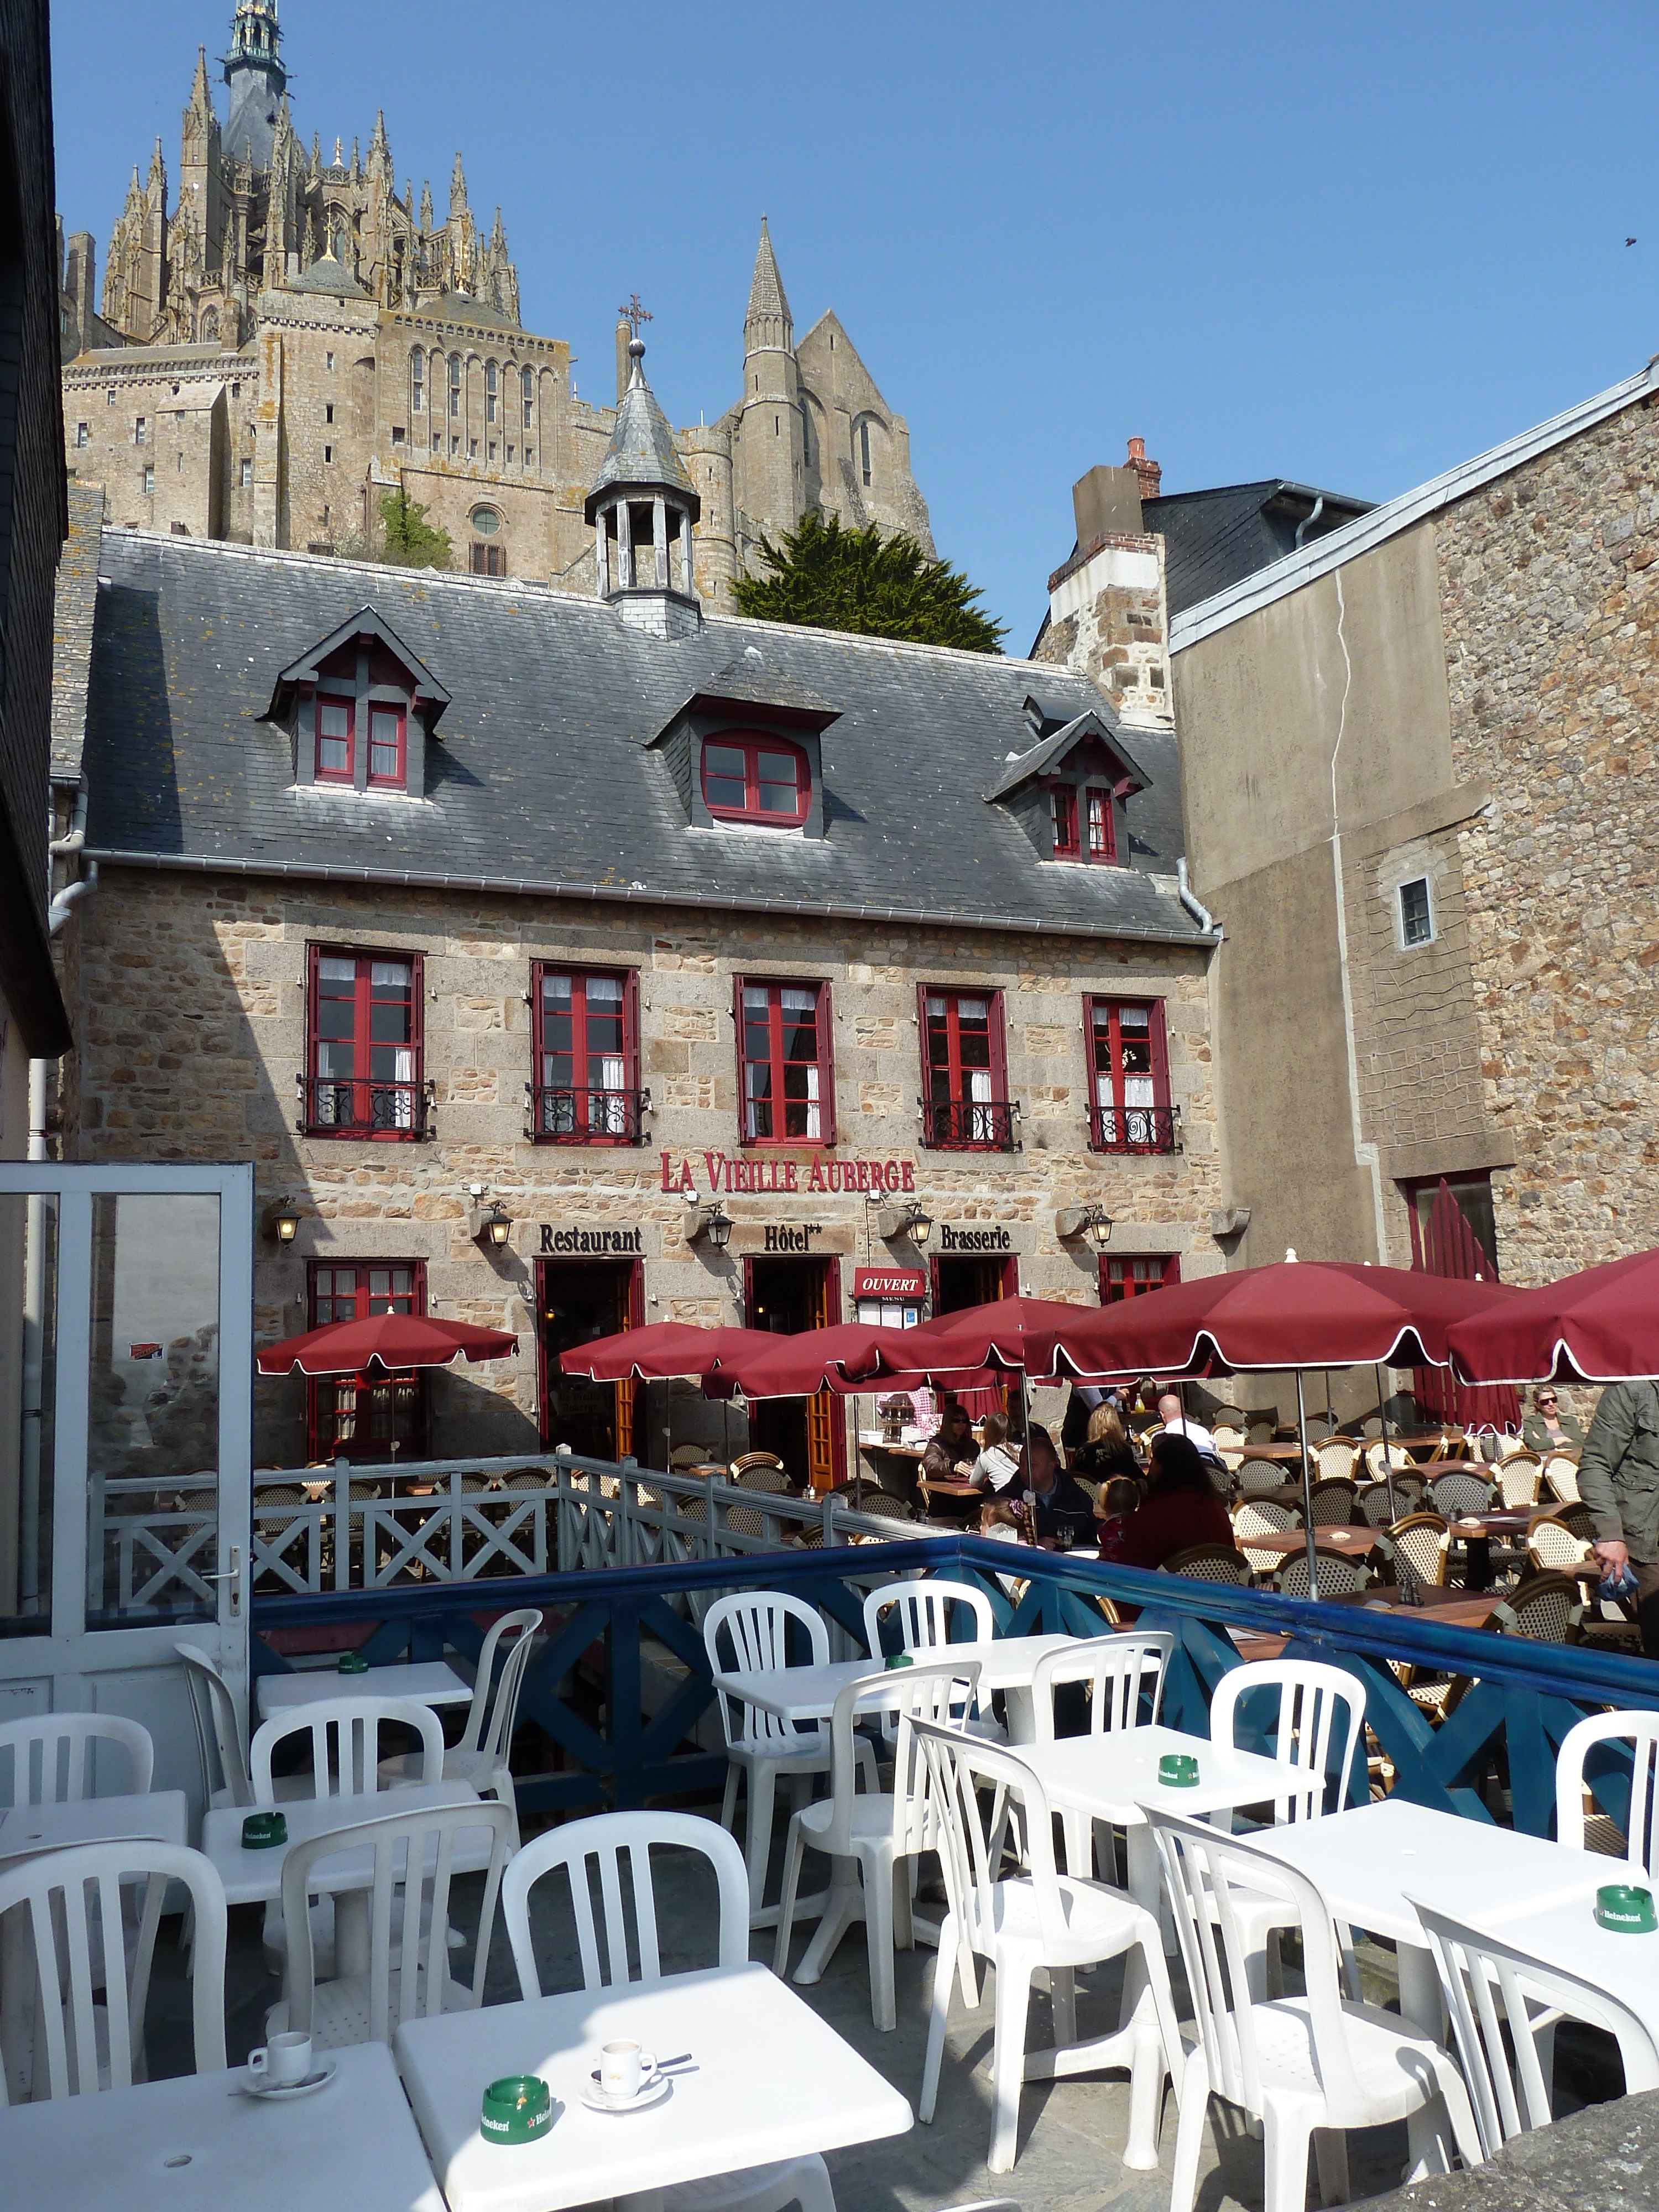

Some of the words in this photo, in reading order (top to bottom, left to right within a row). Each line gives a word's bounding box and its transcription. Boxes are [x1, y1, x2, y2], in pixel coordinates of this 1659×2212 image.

[660, 1152, 695, 1191] LA
[703, 1152, 798, 1191] VIEILLE
[807, 1152, 916, 1191] AUBERGE
[540, 1224, 643, 1253] Restaurant
[940, 1224, 1011, 1250] Brasserie
[863, 1278, 919, 1291] OUVERT
[1604, 1910, 1641, 1922] Heineken
